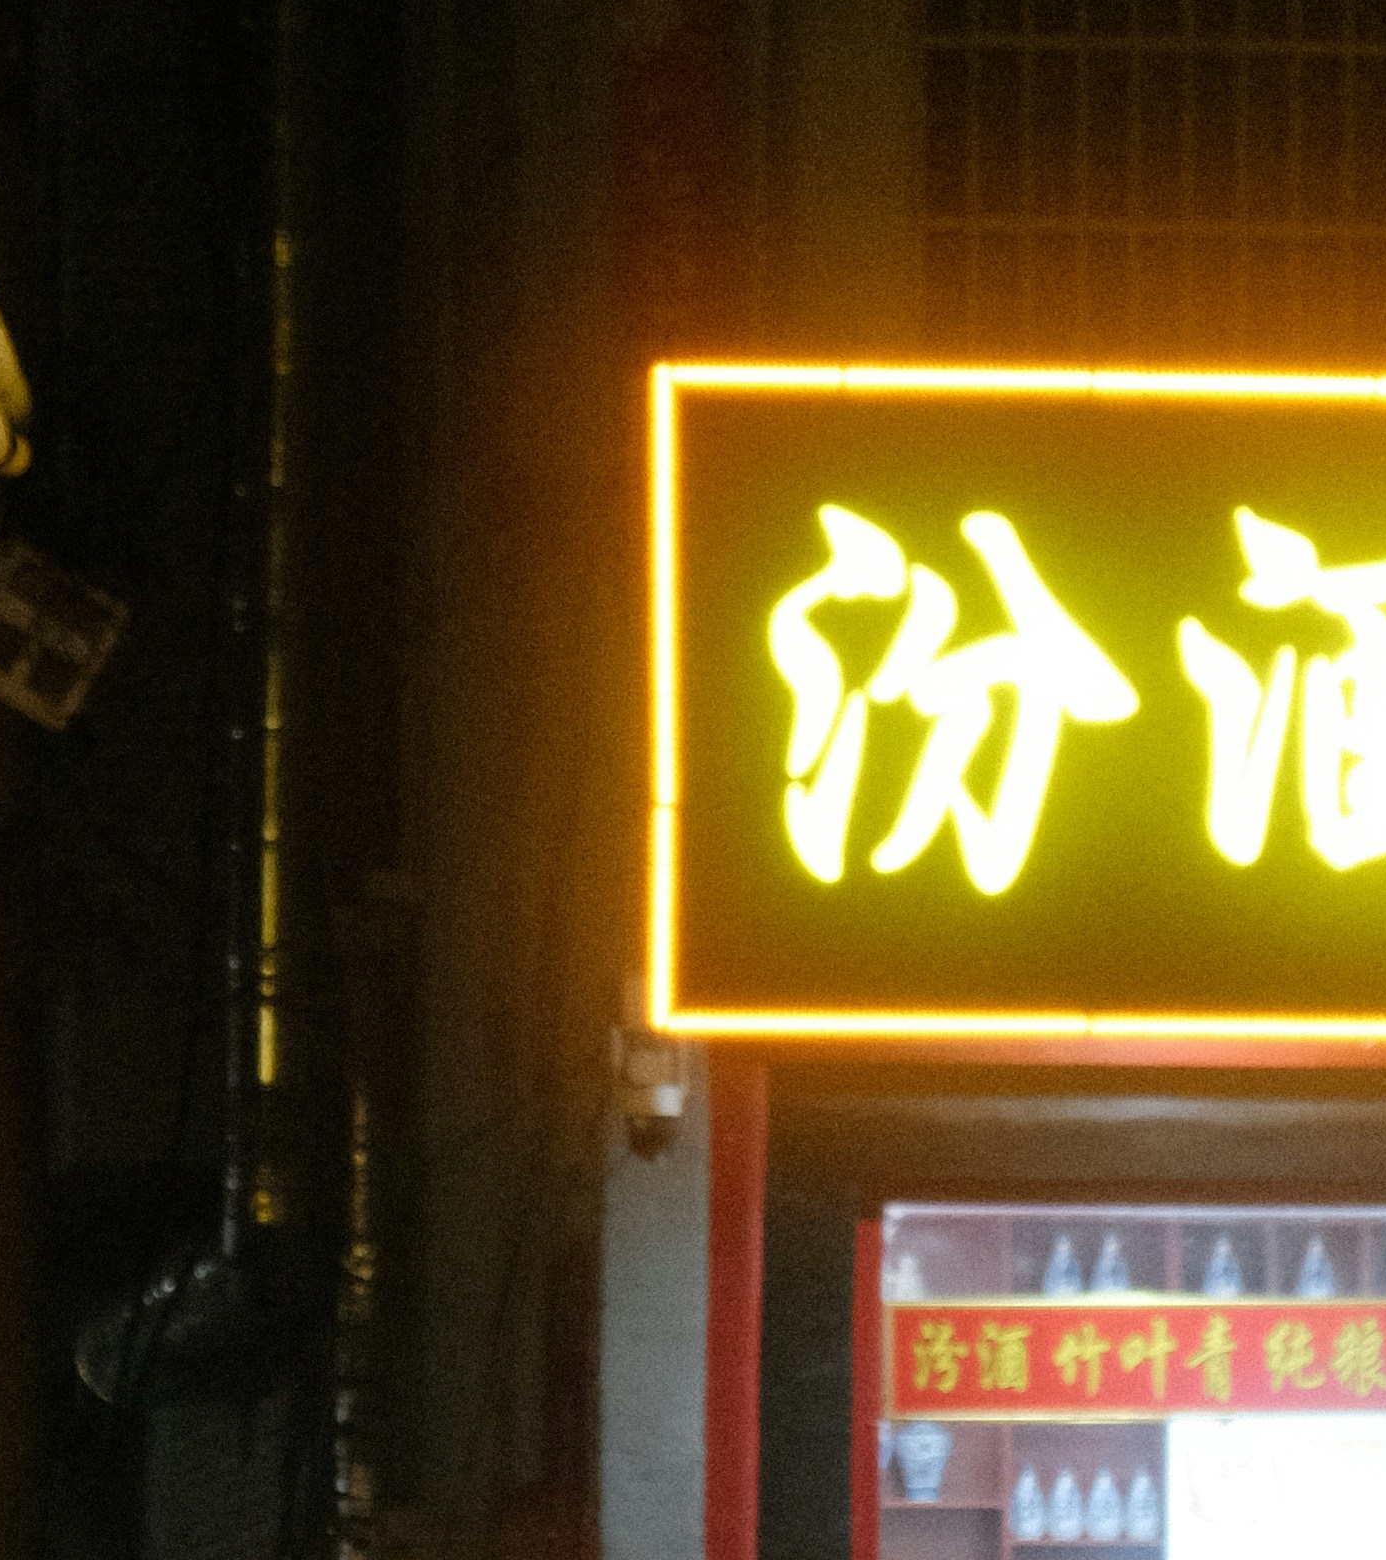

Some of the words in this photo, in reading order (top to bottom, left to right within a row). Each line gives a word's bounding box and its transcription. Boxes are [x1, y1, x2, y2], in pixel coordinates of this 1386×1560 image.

[910, 1317, 1031, 1394] 汾酒
[1051, 1312, 1239, 1403] 竹叶青
